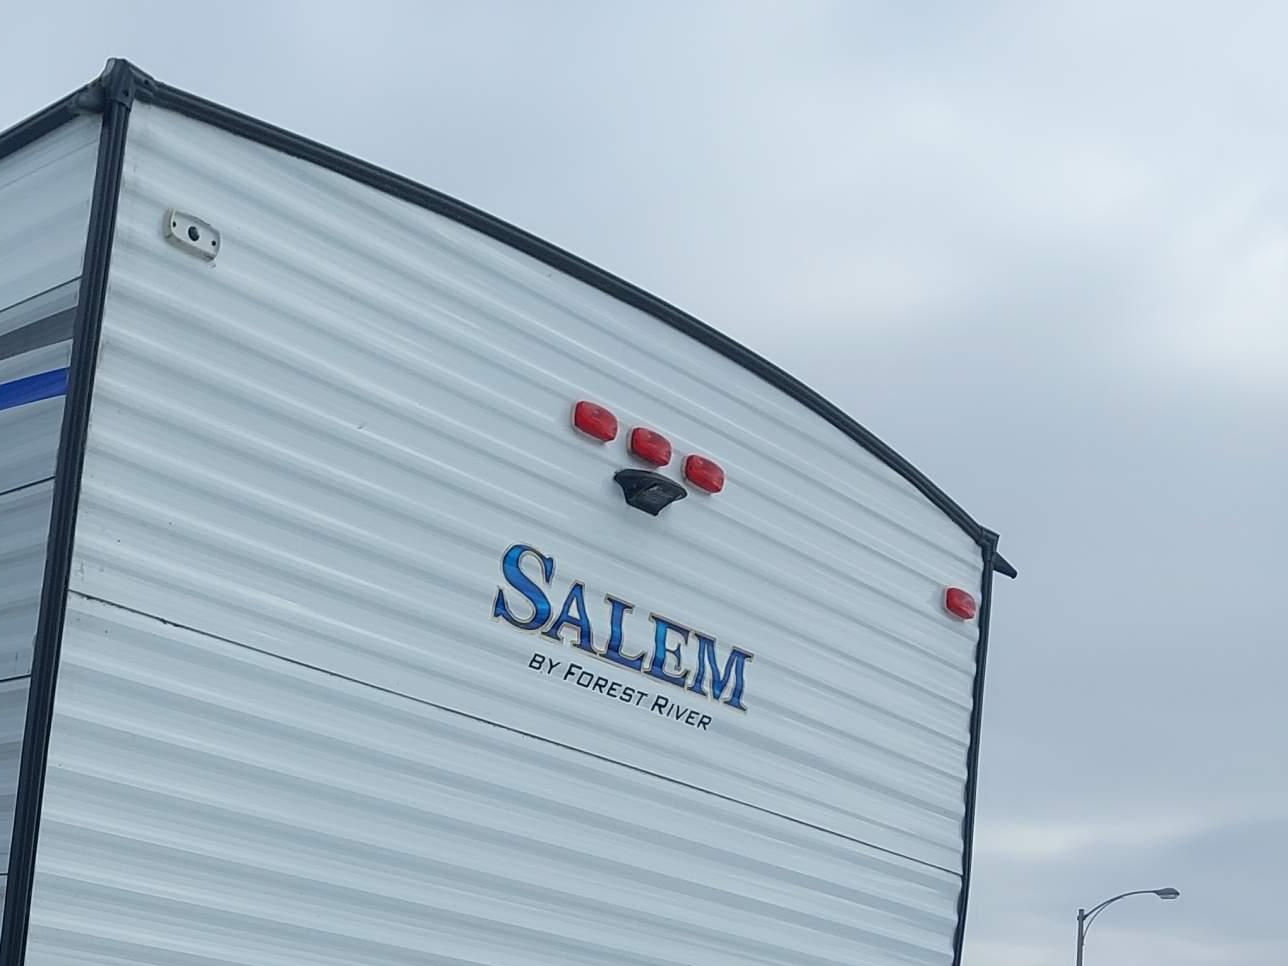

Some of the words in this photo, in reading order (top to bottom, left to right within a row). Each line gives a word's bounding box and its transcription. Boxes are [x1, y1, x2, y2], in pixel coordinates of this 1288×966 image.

[491, 543, 754, 712] SALEM
[528, 652, 561, 675] BY
[563, 663, 649, 707] FOREST
[650, 696, 713, 731] RIVER
